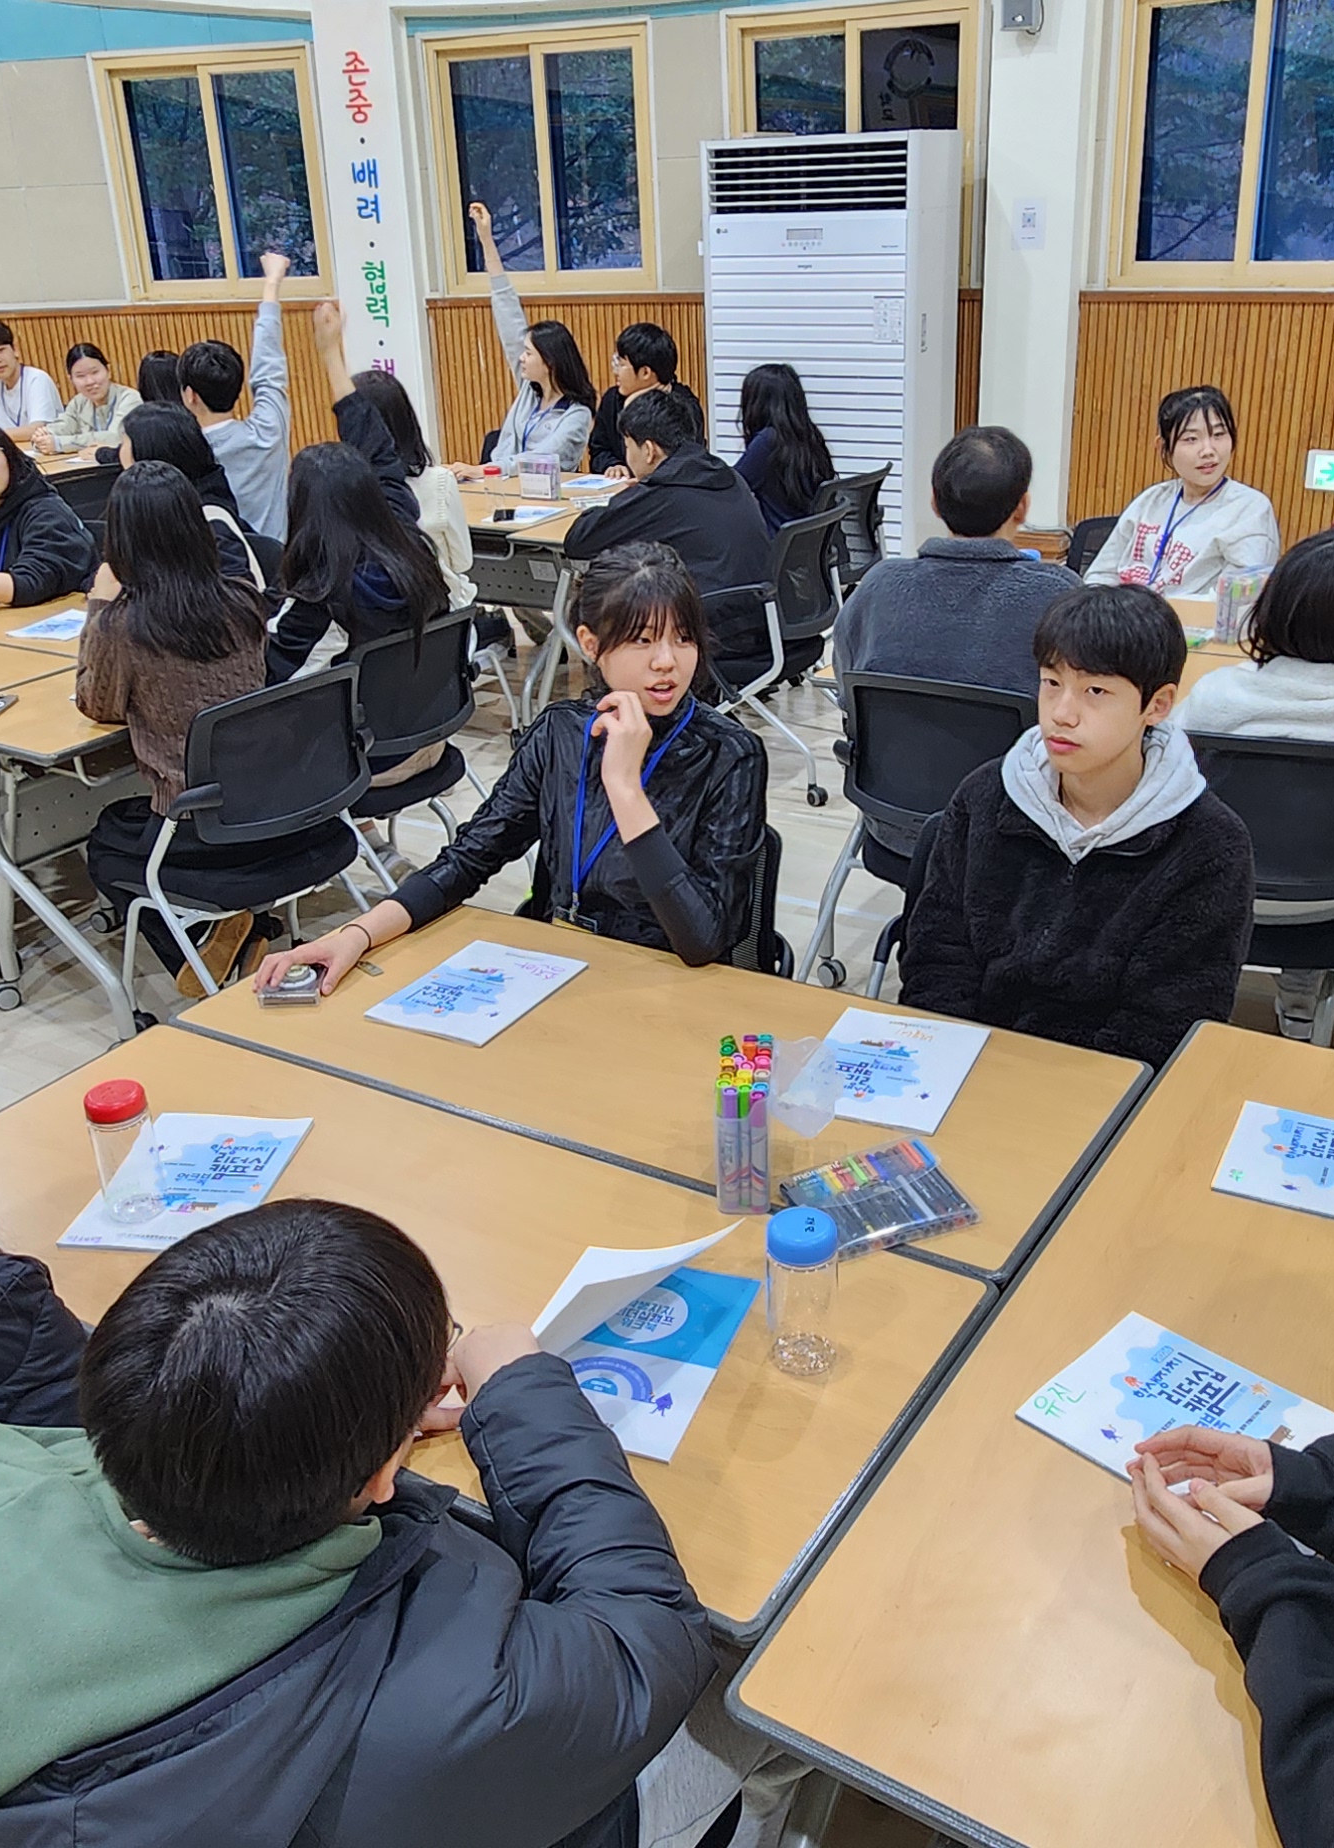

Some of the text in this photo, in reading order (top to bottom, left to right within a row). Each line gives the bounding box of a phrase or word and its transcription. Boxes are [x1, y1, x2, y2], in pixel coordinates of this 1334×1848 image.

[342, 51, 372, 123] 존중
[351, 158, 380, 223] 배려
[361, 260, 389, 328] 협력
[210, 1143, 270, 1155] 학생자치
[213, 1147, 278, 1172] 리더십
[175, 1172, 212, 1186] 워크북
[209, 1164, 259, 1180] 캠프
[1133, 1357, 1182, 1398] 학생자치
[1157, 1352, 1227, 1405] 리더십
[1034, 1382, 1086, 1418] 유진
[1183, 1381, 1241, 1417] 캠프
